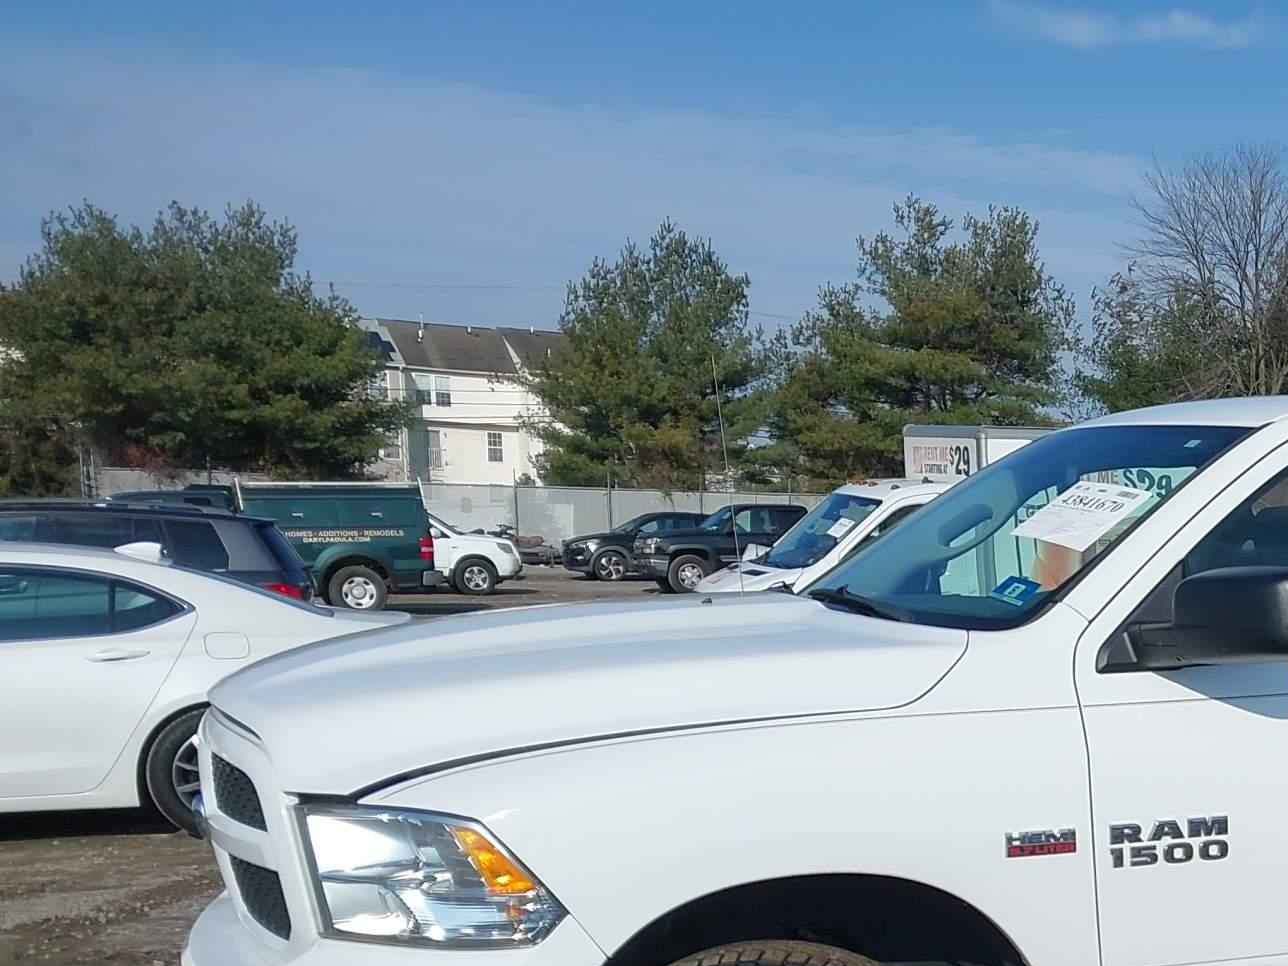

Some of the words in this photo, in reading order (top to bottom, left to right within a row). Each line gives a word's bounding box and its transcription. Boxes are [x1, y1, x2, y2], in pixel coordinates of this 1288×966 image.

[949, 444, 970, 477] $29
[1062, 494, 1125, 513] 43841670
[318, 530, 358, 538] ADDITIONS
[1005, 828, 1076, 846] HEMI
[1109, 815, 1229, 845] RAM
[1110, 838, 1229, 869] 1500
